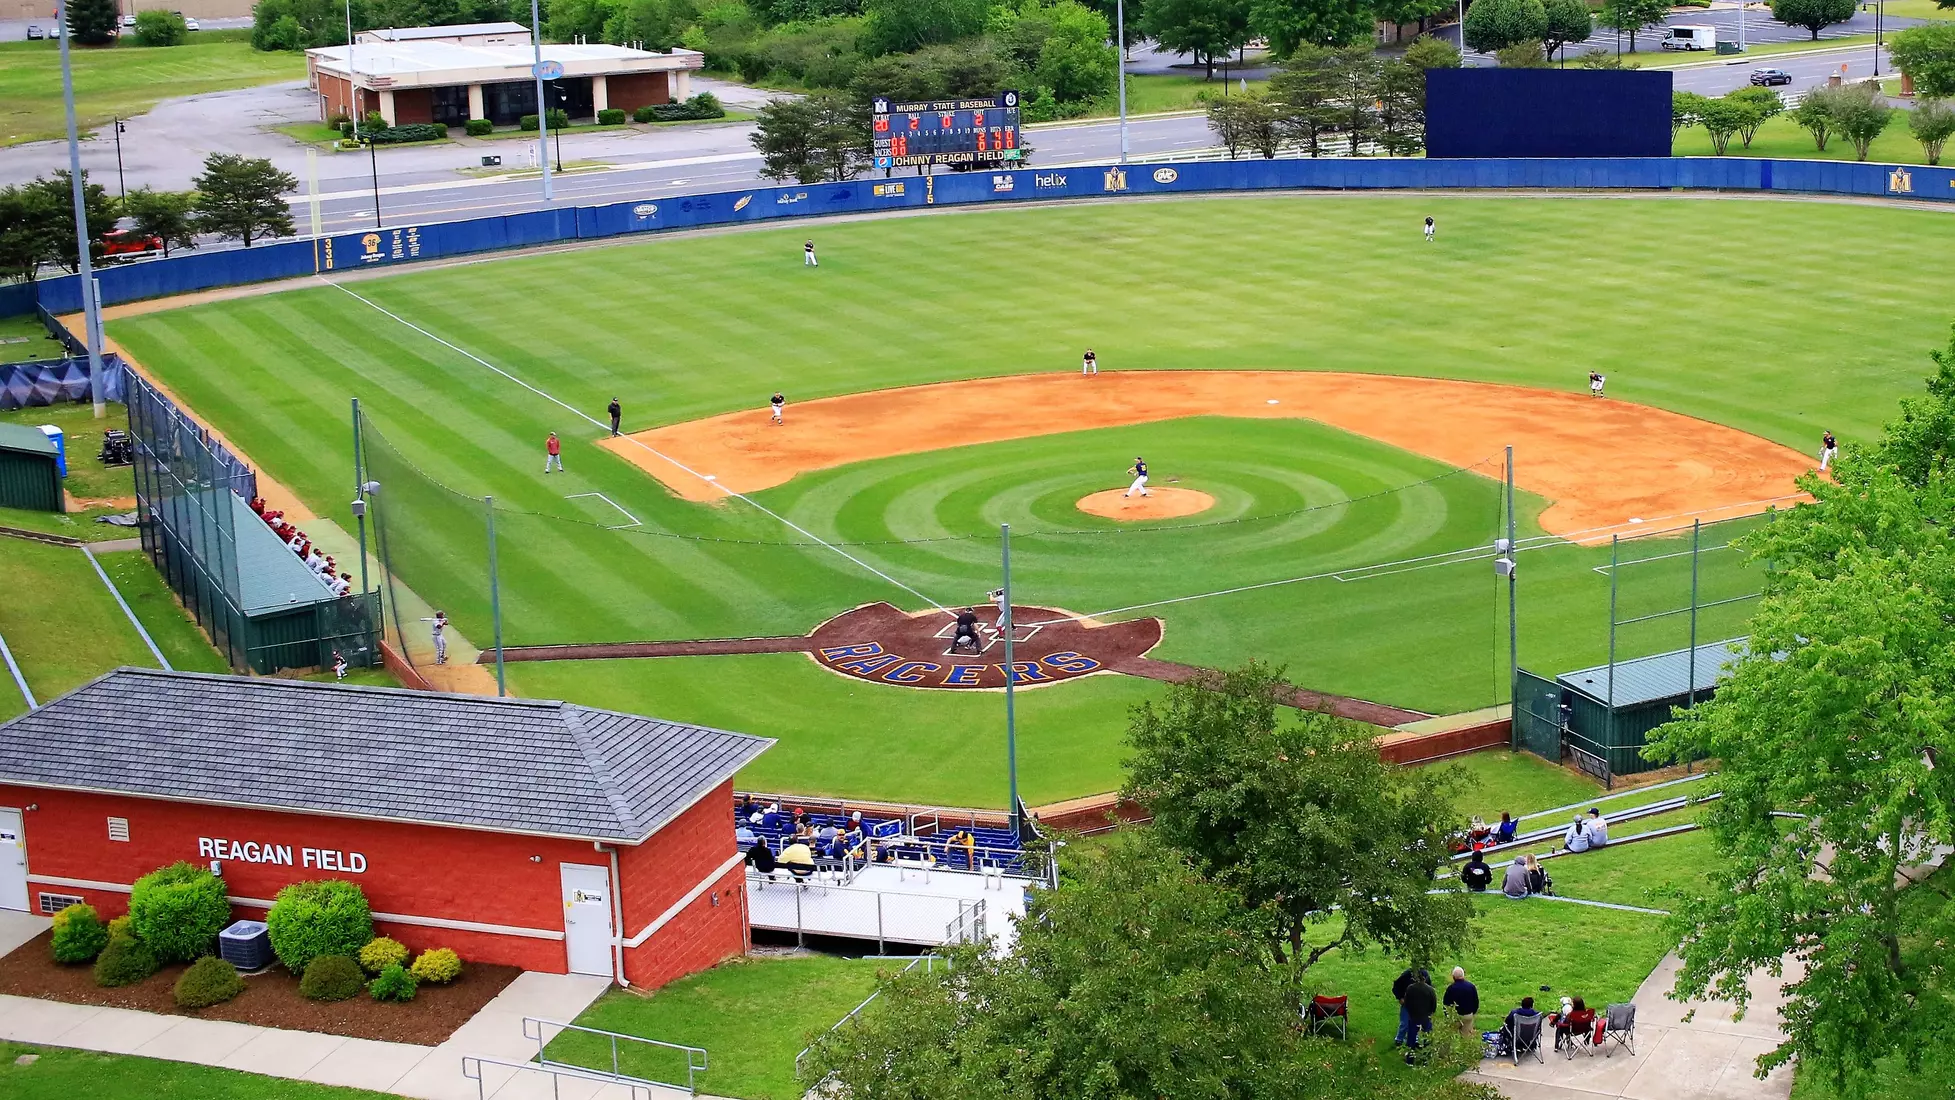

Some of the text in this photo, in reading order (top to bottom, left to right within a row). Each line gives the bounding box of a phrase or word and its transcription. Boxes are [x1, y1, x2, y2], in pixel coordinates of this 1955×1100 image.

[896, 100, 996, 112] MURRAY STATE BASEBALL
[907, 112, 921, 120] BALL
[974, 114, 983, 126] 2
[909, 119, 918, 130] 2
[942, 116, 952, 128] 0
[978, 131, 1013, 141] 2 4 0
[874, 139, 891, 148] GUEST
[891, 137, 906, 147] 0 2
[978, 139, 1013, 151] 0 0 0
[874, 148, 892, 157] RACERS
[891, 146, 906, 156] 0 0
[892, 155, 931, 167] JOHNNY
[935, 153, 973, 164] REAGAN
[978, 151, 1004, 161] FIELD
[1035, 173, 1067, 187] helix
[367, 238, 376, 247] 36
[820, 641, 1102, 686] RACERS
[198, 837, 368, 874] REAGAN FIELD
